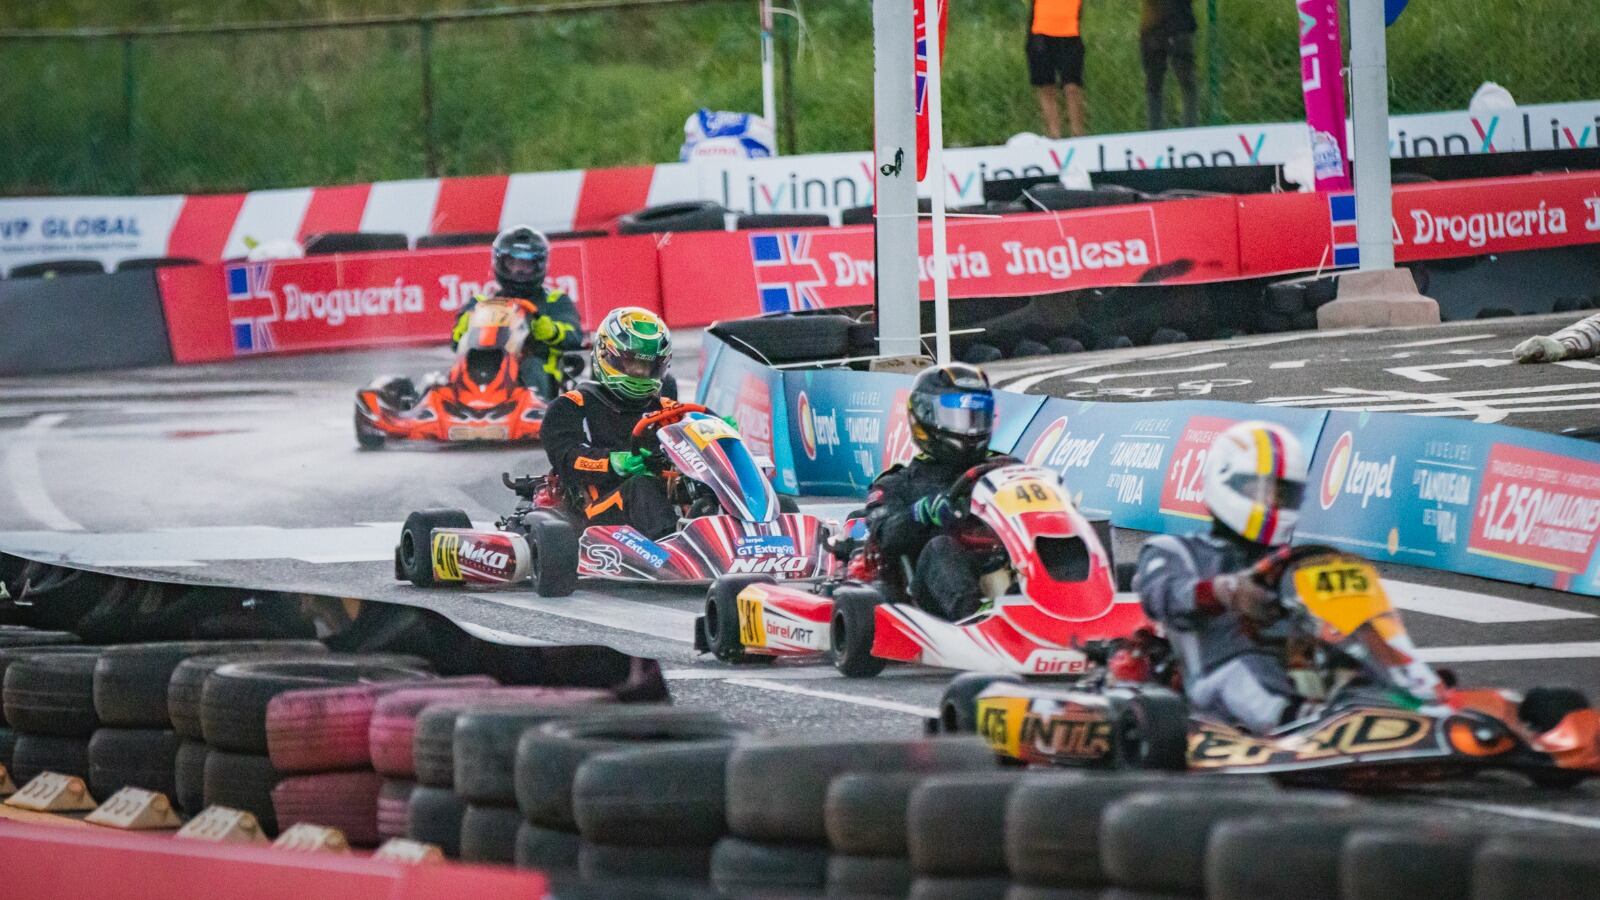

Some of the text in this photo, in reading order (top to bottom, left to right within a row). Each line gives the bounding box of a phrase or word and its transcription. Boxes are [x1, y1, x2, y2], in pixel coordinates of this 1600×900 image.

[42, 217, 139, 238] GLOBAL
[1409, 199, 1567, 248] Droguería
[1002, 235, 1150, 279] Inglesa
[281, 278, 425, 326] Droguería
[812, 408, 840, 455] terpel
[1048, 432, 1104, 478] terpel
[1116, 474, 1144, 505] VIDA
[1344, 452, 1397, 509] terpel
[737, 546, 754, 556] GT
[1315, 568, 1368, 593] 475
